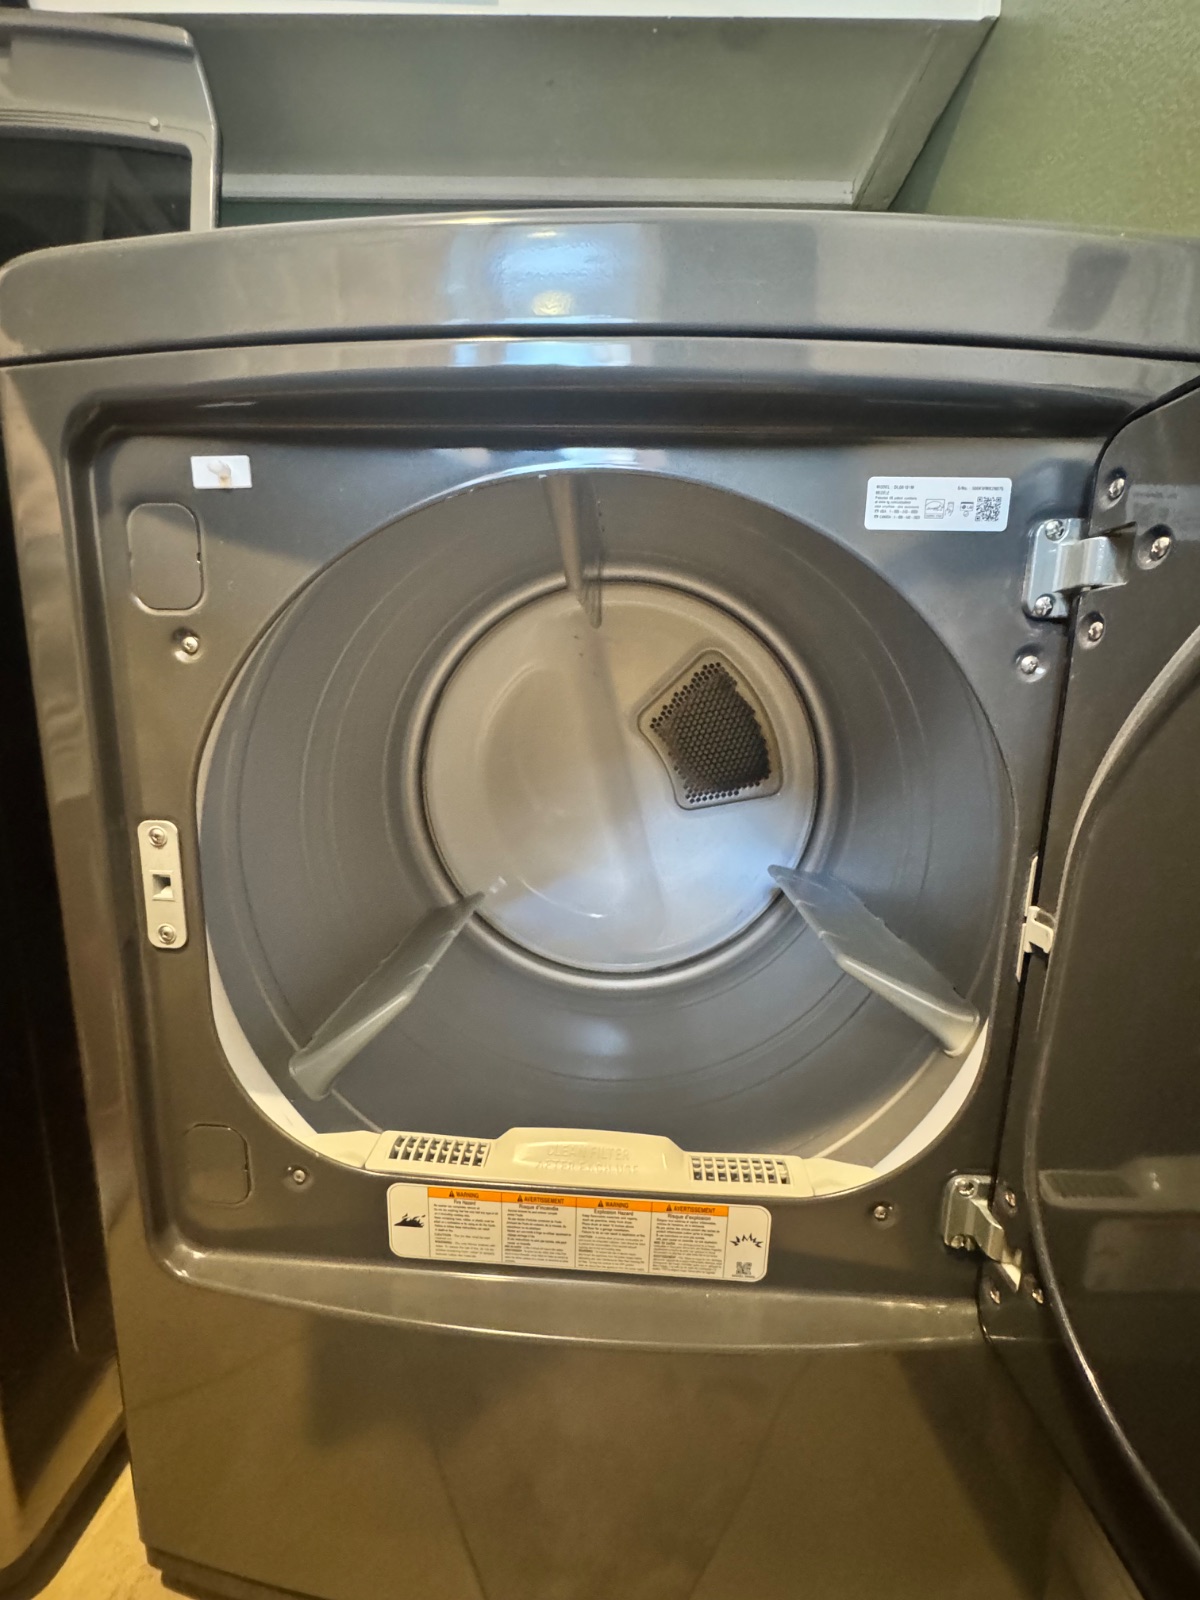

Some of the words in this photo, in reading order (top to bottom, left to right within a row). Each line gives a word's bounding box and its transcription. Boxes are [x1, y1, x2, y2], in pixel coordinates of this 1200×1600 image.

[547, 1144, 588, 1158] CLEAN
[590, 1146, 630, 1161] FILTER
[536, 1159, 575, 1171] AFTER
[456, 1191, 480, 1199] WARNING
[524, 1196, 565, 1205] AVERTISSEMENT
[605, 1201, 629, 1209] WARNING
[519, 1203, 535, 1211] Risque
[673, 1205, 716, 1214] AVERTISSEMENT
[685, 1213, 712, 1222] d'explosion
